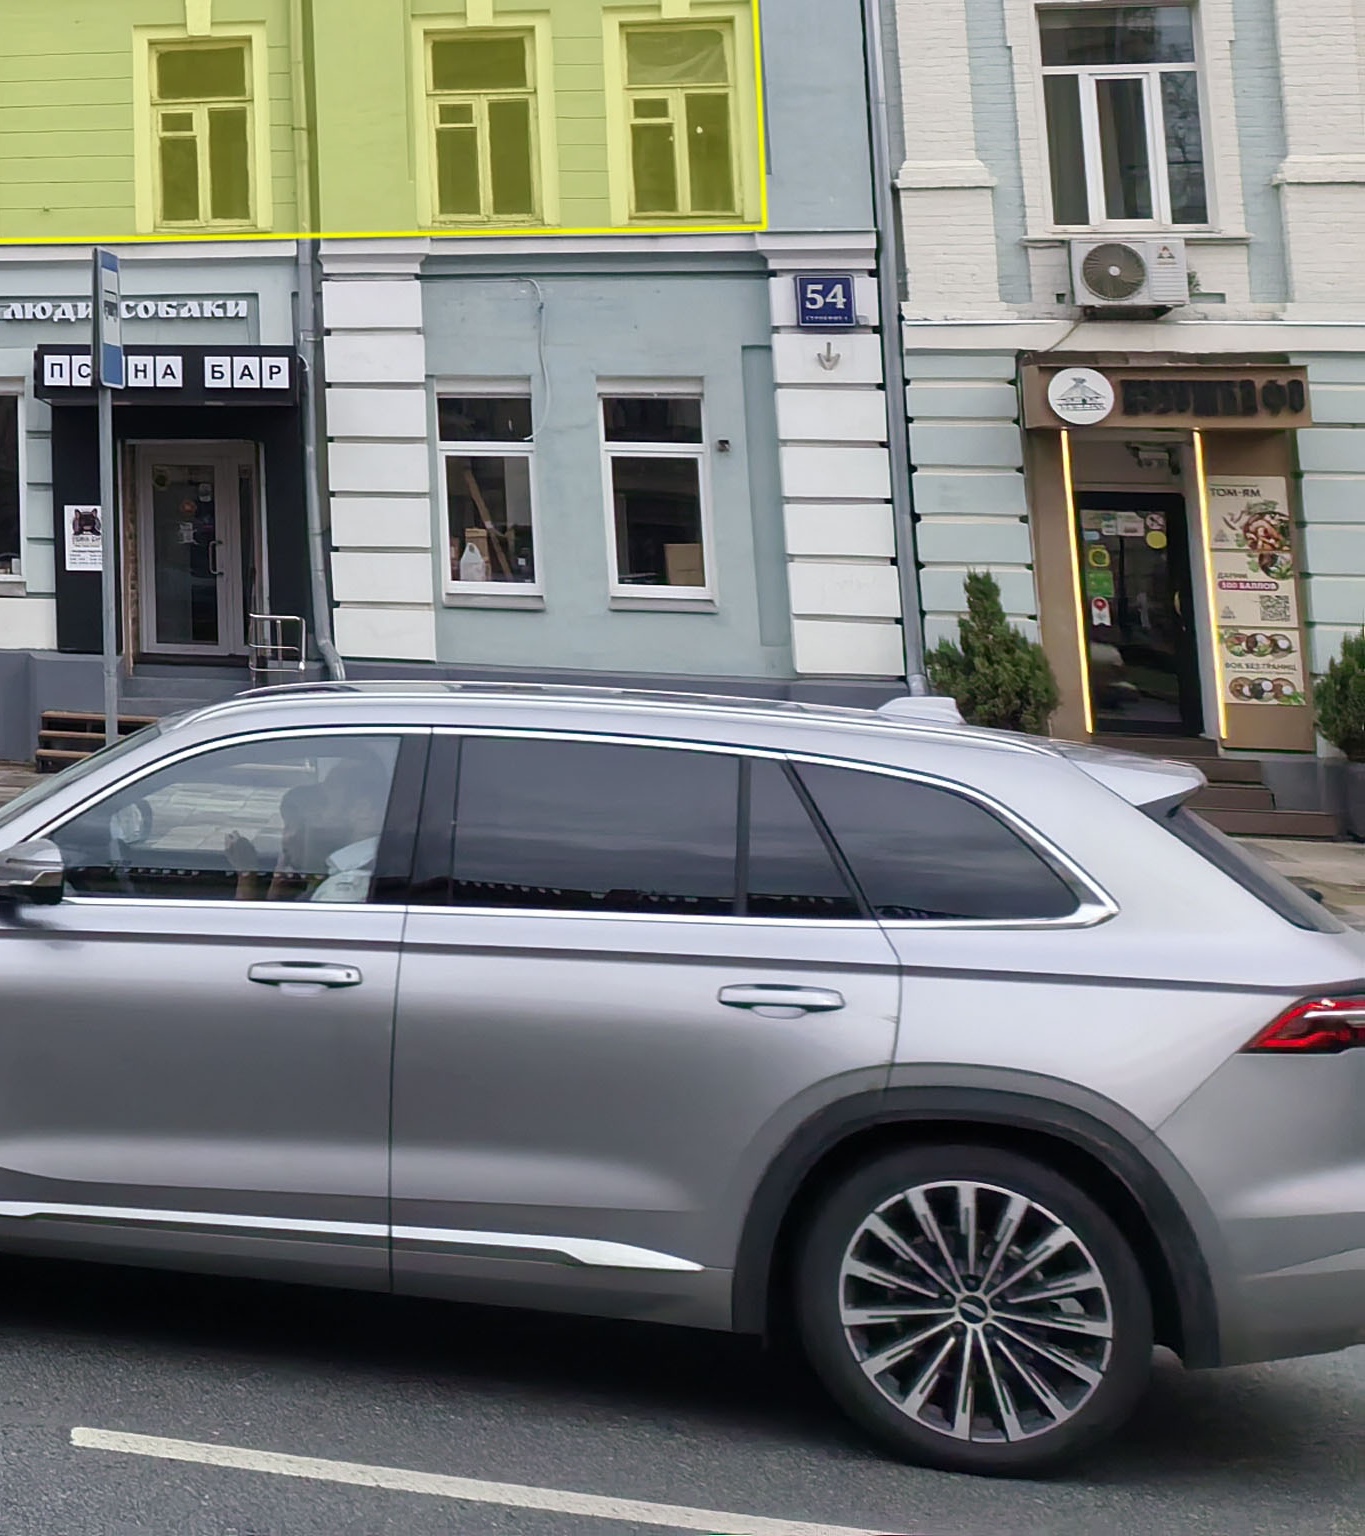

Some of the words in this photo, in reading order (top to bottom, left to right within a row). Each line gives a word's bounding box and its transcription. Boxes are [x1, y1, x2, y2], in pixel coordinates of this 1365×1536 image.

[805, 284, 847, 310] 54
[50, 362, 177, 380] ПСНА
[211, 364, 282, 381] БАР
